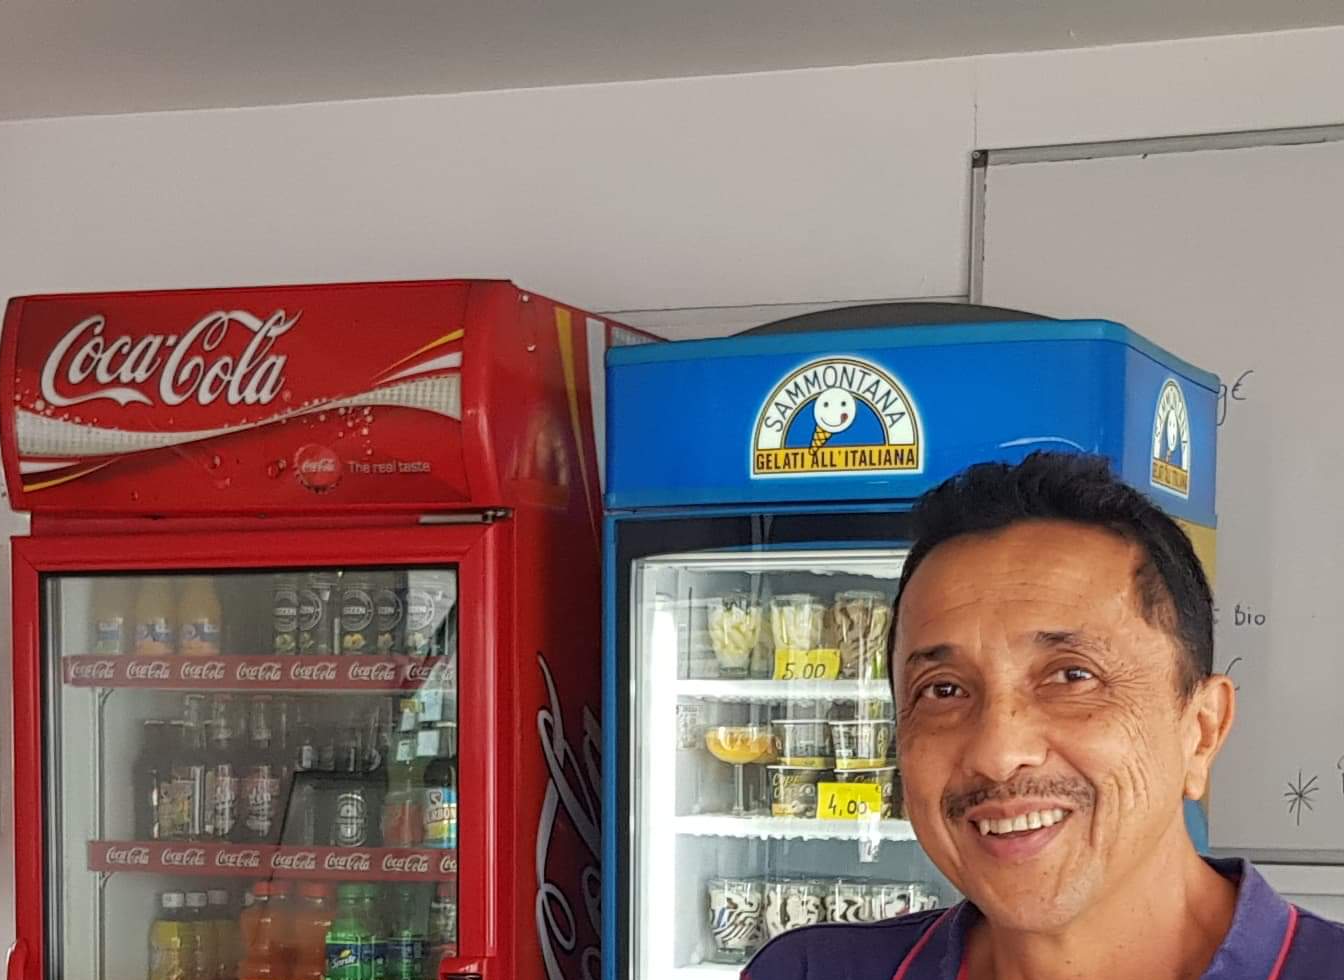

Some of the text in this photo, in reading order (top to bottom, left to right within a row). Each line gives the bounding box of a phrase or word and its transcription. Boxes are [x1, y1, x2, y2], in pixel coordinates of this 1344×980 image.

[40, 308, 304, 407] Coca-Cola
[763, 364, 907, 433] SAMMONTANA
[755, 448, 916, 470] GELATI ALL'ITALIANA
[1233, 604, 1267, 627] Bio
